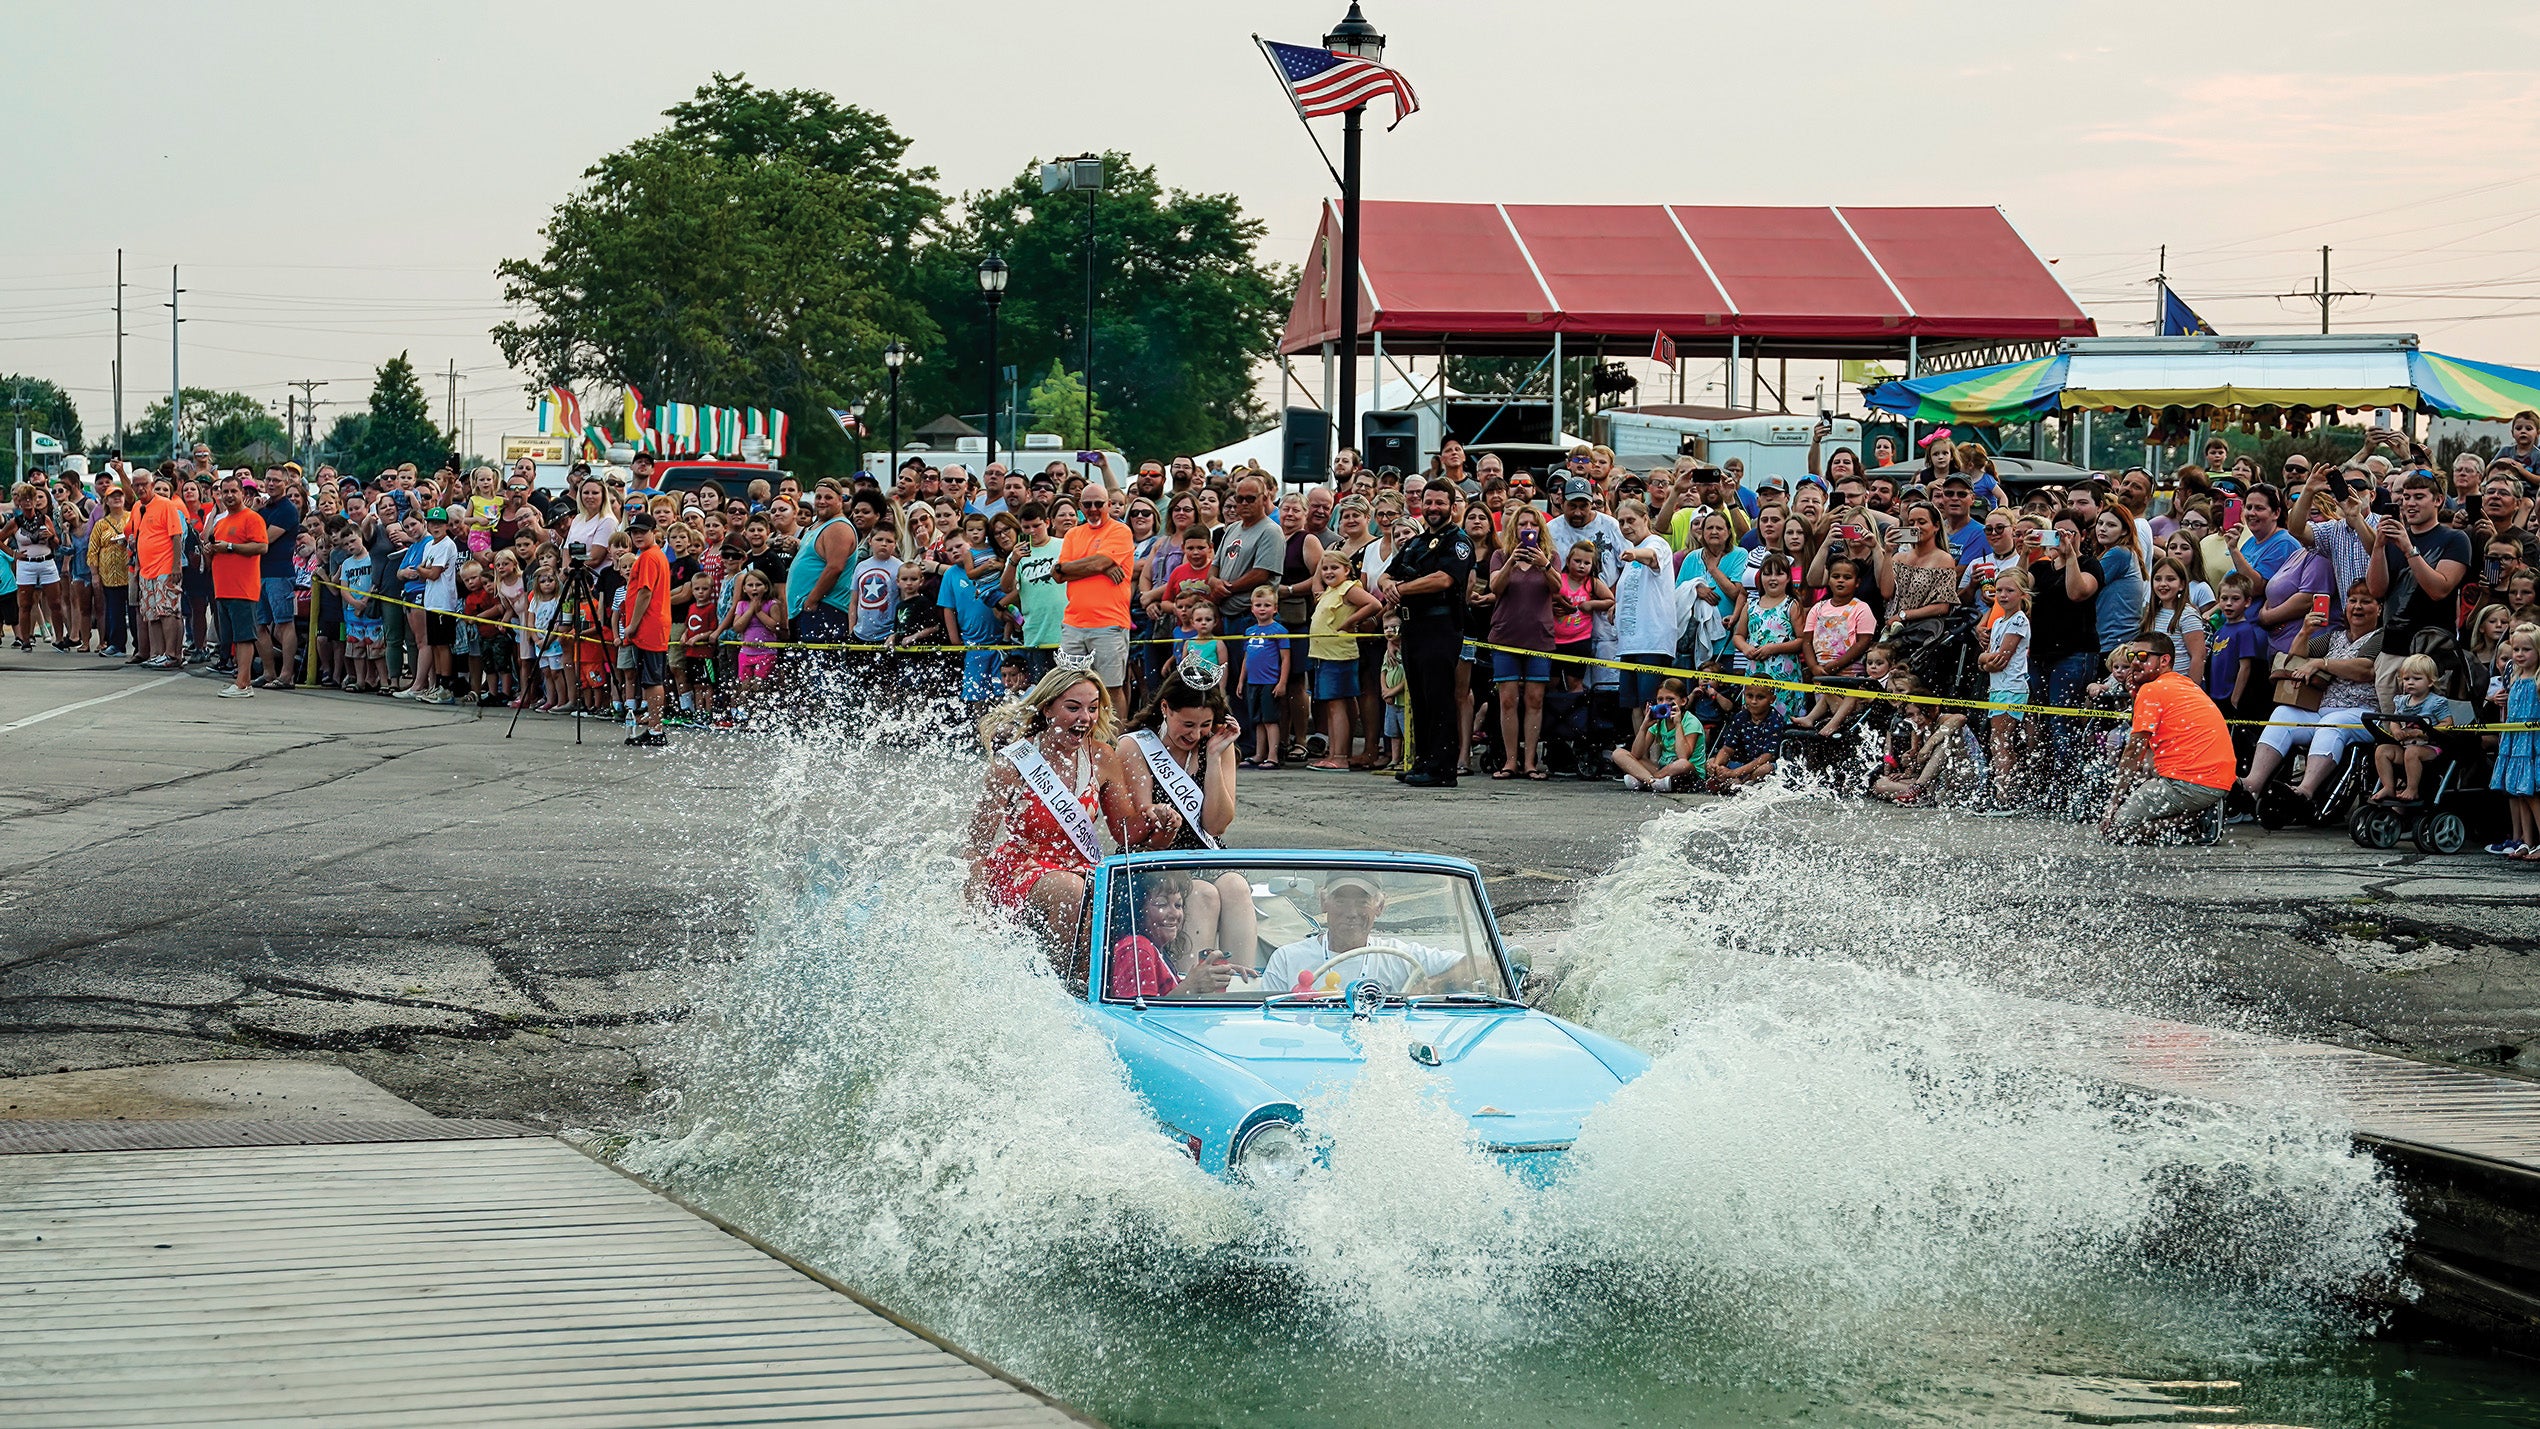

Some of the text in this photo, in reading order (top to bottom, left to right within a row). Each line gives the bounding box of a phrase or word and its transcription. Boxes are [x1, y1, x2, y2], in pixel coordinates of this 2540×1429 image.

[687, 614, 703, 631] C
[1028, 763, 1054, 795] Miss
[1050, 791, 1077, 823] Lake
[1149, 750, 1199, 812] Miss Lake
